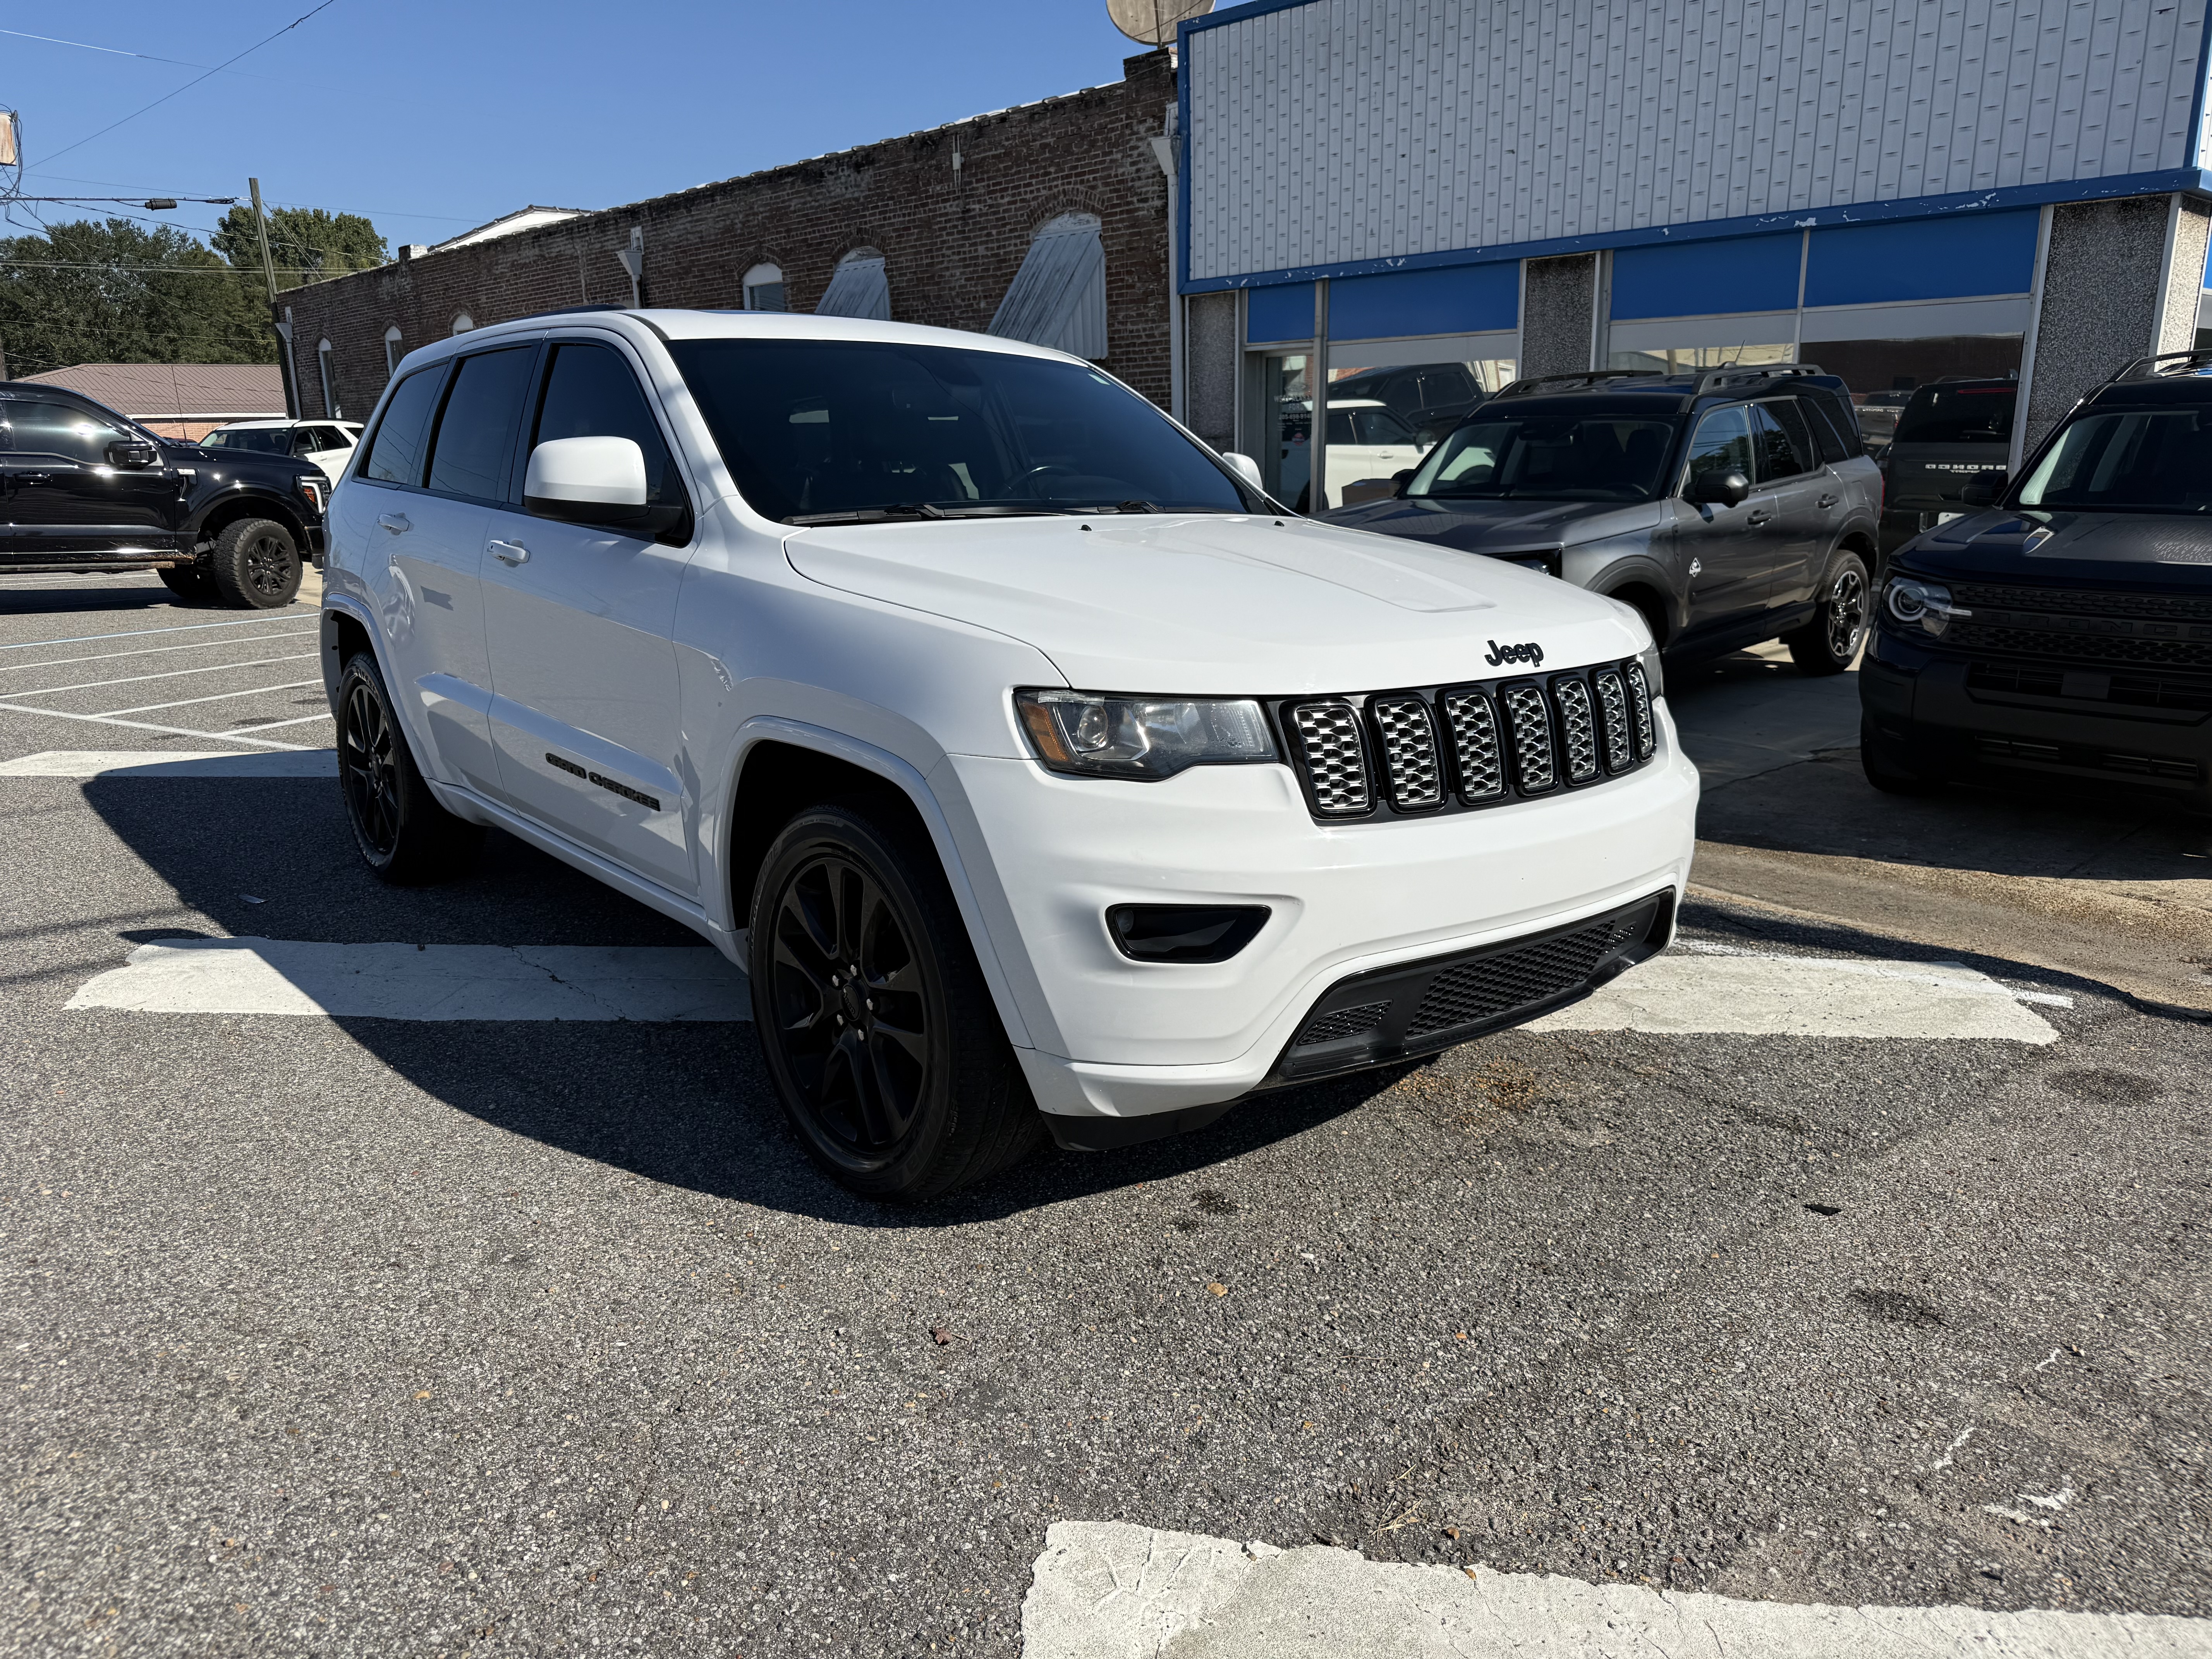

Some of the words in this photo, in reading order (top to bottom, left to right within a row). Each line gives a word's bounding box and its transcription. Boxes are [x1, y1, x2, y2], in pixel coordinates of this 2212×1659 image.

[1484, 640, 1544, 668] Jeep
[545, 752, 587, 779] GRAND
[588, 772, 661, 812] CHEROKEE
